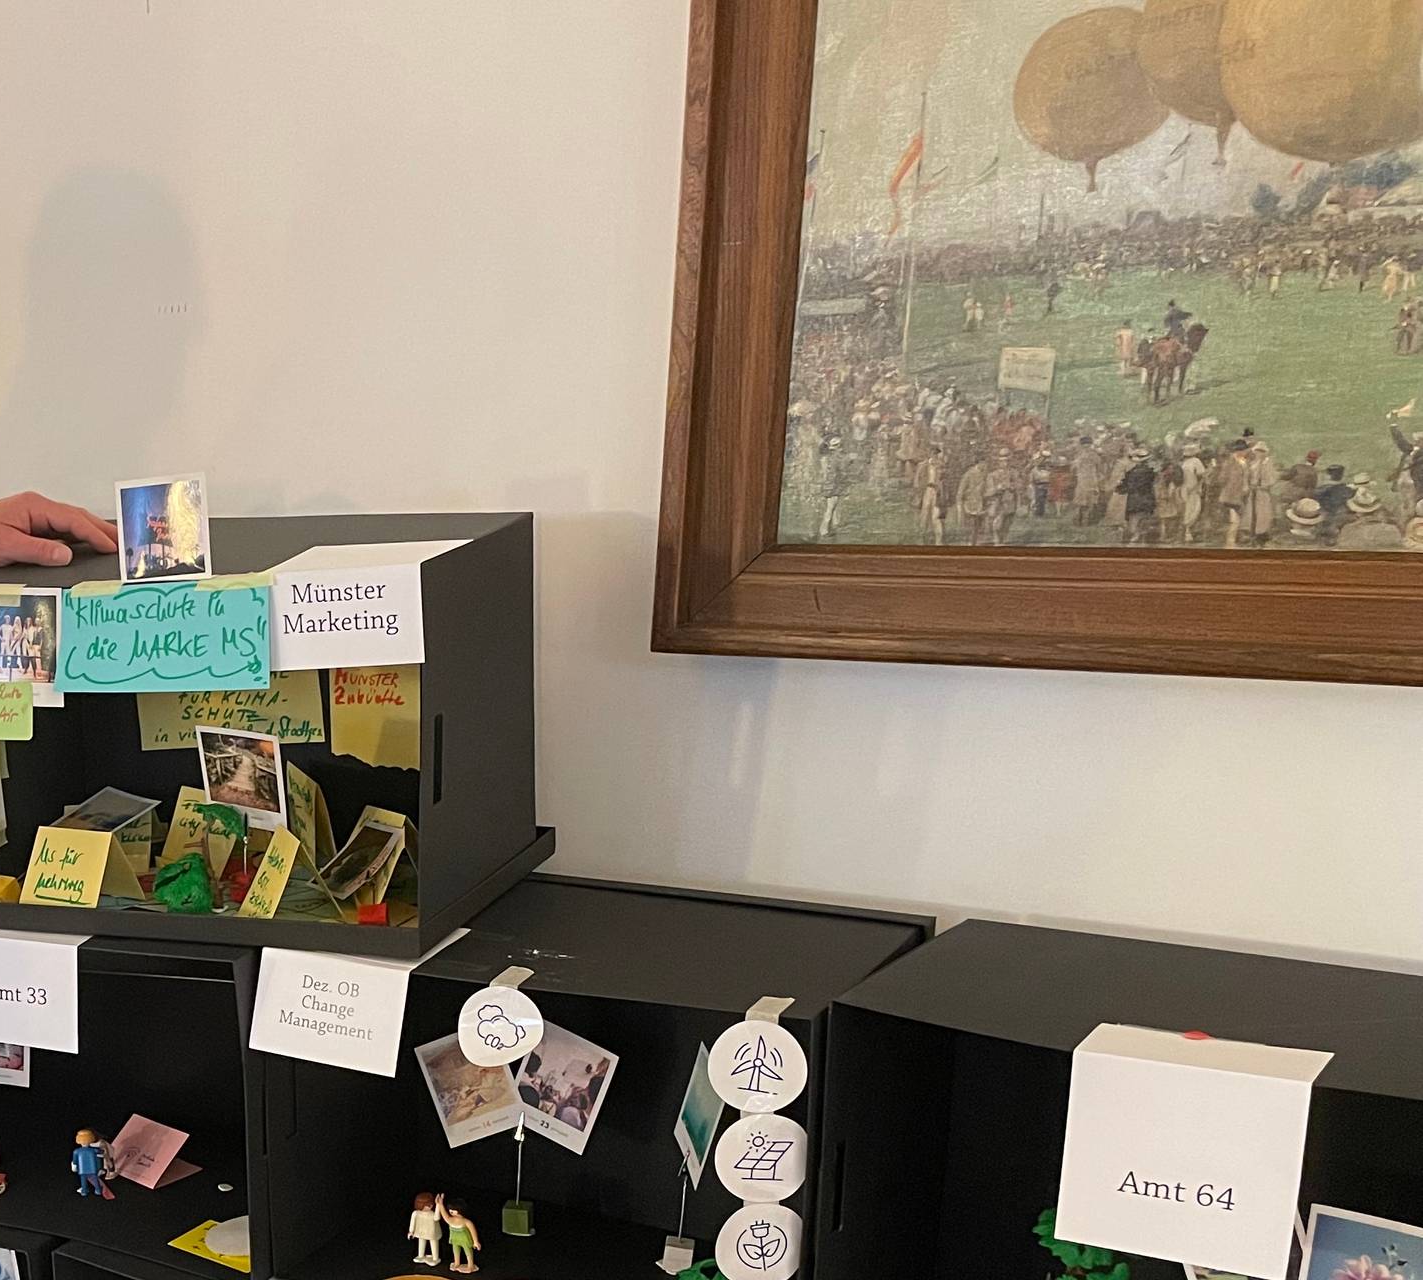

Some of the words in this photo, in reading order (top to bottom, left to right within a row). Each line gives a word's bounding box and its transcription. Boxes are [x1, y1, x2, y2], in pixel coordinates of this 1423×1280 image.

[291, 583, 386, 604] Münster
[283, 610, 399, 635] Marketing
[87, 636, 118, 661] die
[127, 629, 210, 666] MARKE
[221, 690, 289, 708] KLIMA-
[182, 705, 268, 723] SCHUTZ
[154, 727, 169, 743] in
[59, 847, 85, 871] für
[26, 986, 47, 1005] 33
[302, 974, 333, 993] Dez.
[337, 981, 360, 998] OB
[301, 994, 355, 1020] Change
[279, 1009, 374, 1041] Management
[1117, 1170, 1186, 1203] Amt
[1196, 1183, 1236, 1211] 64
